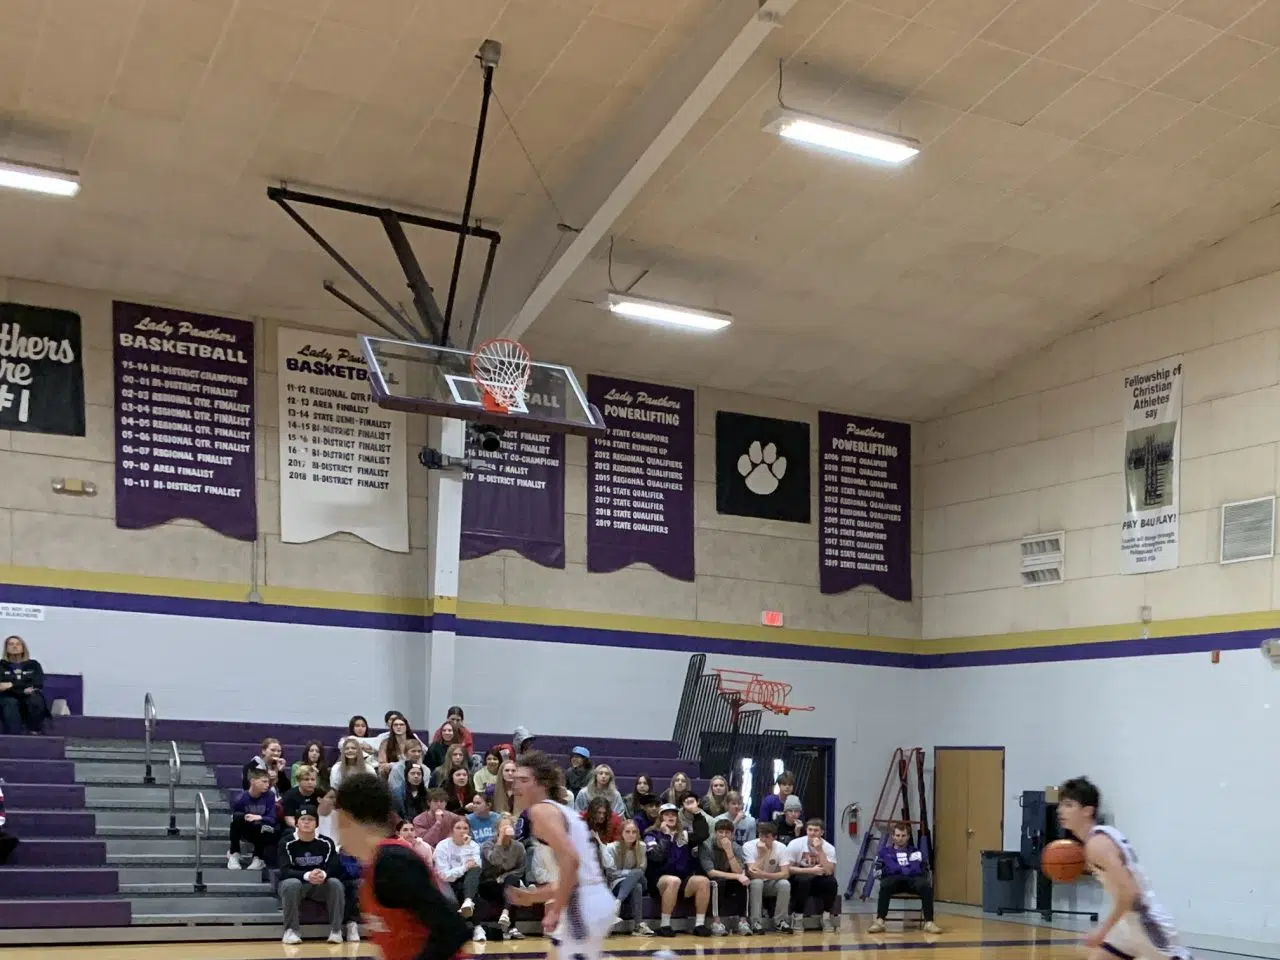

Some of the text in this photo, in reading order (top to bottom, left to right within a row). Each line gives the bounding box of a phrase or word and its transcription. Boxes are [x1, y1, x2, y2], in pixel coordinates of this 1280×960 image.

[134, 317, 236, 342] Lady Panthers
[120, 334, 248, 364] BASKETBALL
[298, 344, 332, 362] Lady
[200, 371, 248, 385] CHAMPIONS
[286, 358, 399, 384] BASKETBL
[1124, 363, 1182, 388] Fellowship of
[202, 386, 238, 398] FINALIST
[310, 386, 348, 399] REGIONAL
[1133, 382, 1172, 398] Christian
[604, 388, 680, 408] Lady Panthers
[1134, 394, 1170, 410] Athletes
[214, 400, 250, 414] FINALIST
[313, 400, 332, 410] AREA
[336, 403, 369, 414] FINALIST
[214, 413, 250, 427] FINALIST
[313, 412, 332, 422] STATE
[604, 404, 680, 426] POWERLIFTING
[1145, 409, 1158, 420] say
[152, 420, 193, 432] REGIONAL
[214, 428, 250, 440] FINALIST
[358, 430, 390, 440] FINALIST
[520, 430, 550, 443] FINALIST
[612, 428, 630, 438] STATE
[632, 432, 668, 444] CHAMPIONS
[846, 423, 884, 439] Panthers
[153, 434, 193, 446] REGIONAL
[214, 441, 250, 453] FINALIST
[359, 442, 391, 452] FINALIST
[520, 443, 550, 455] FINALIST
[612, 440, 630, 450] STATE
[832, 438, 898, 458] POWERLIFTING
[153, 448, 194, 460] REGIONAL
[197, 454, 232, 466] FINALIST
[358, 454, 390, 464] FINALIST
[612, 452, 644, 464] REGIONAL
[646, 457, 682, 469] QUALIFIERS
[153, 464, 175, 474] AREA
[178, 467, 214, 478] FINALIST
[358, 467, 389, 478] FINALIST
[612, 464, 644, 474] REGIONAL
[646, 468, 682, 480] QUALIFIERS
[289, 472, 306, 480] 2018
[358, 479, 389, 490] FINALIST
[516, 478, 546, 490] FINALIST
[646, 480, 682, 491] QUALIFIERS
[204, 486, 241, 498] FINALIST
[613, 488, 630, 496] STATE
[632, 490, 664, 500] QUALIFIER
[595, 496, 664, 510] 2017 STATE QUALIFIER
[613, 510, 631, 518] STATE
[633, 512, 664, 522] QUALIFIER
[613, 521, 631, 530] STATE
[633, 523, 668, 534] QUALIFIERS
